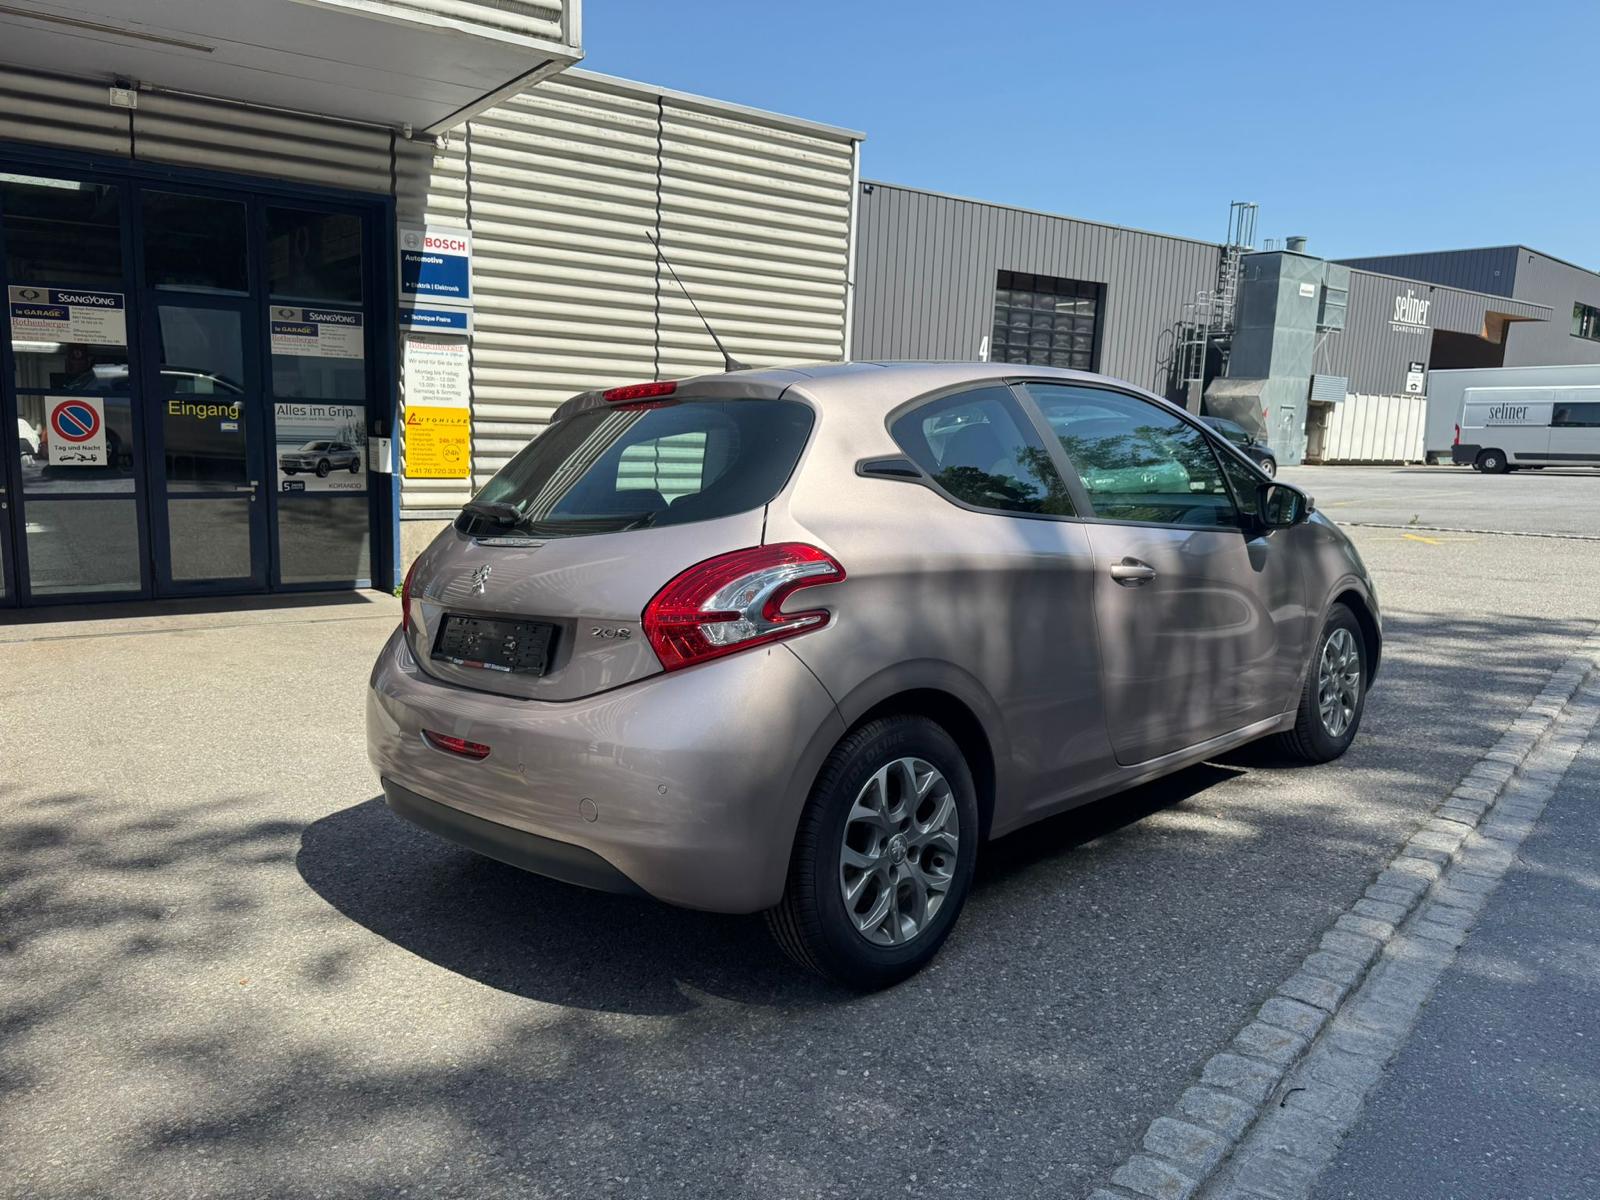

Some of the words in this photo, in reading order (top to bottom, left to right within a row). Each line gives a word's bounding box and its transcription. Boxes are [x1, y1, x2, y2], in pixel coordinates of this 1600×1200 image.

[425, 237, 466, 252] BOSCH
[405, 254, 443, 264] Automotive
[434, 283, 459, 292] Elektronik
[24, 309, 61, 317] GARAGE
[1393, 289, 1431, 325] seliner
[12, 318, 71, 329] Rothenberger
[411, 314, 436, 322] Technique
[979, 336, 988, 362] 4
[168, 400, 239, 420] Eingang
[277, 405, 307, 416] Alles
[309, 406, 325, 416] im
[328, 406, 357, 419] Grip.
[1488, 403, 1528, 420] seliner
[283, 482, 290, 491] 5
[591, 627, 631, 640] 208
